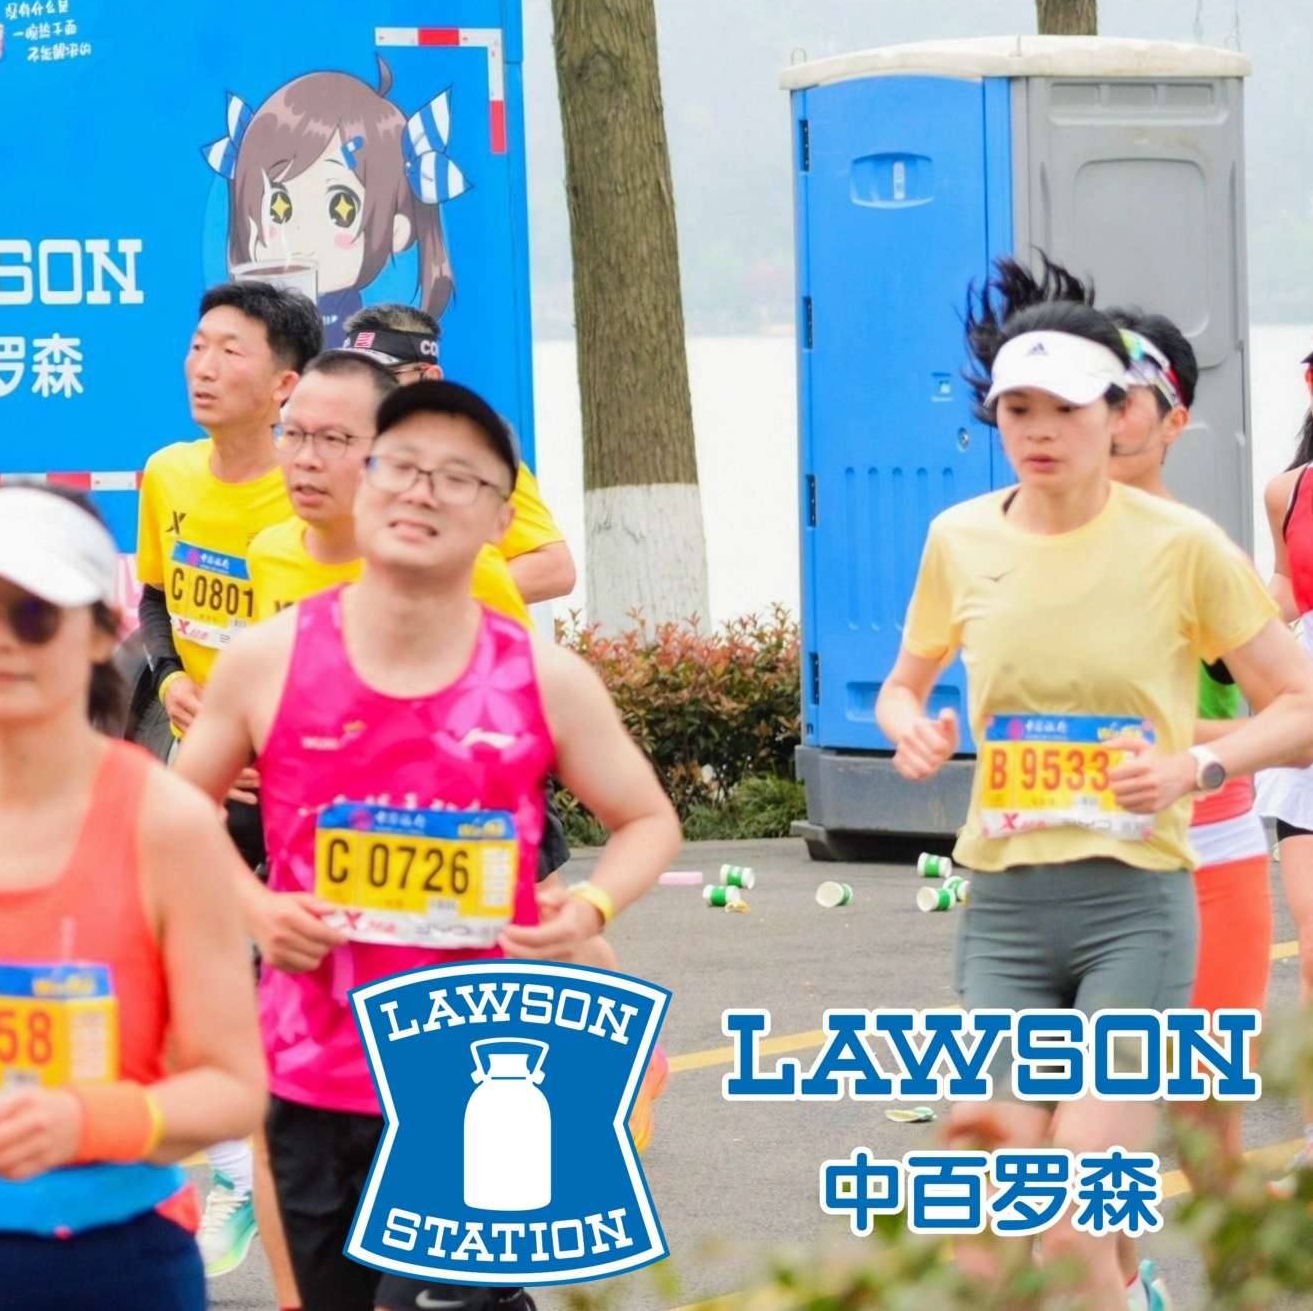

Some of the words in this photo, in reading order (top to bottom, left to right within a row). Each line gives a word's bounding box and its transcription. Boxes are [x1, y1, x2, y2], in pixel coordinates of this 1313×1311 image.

[171, 568, 185, 601] C
[193, 575, 255, 618] 0801
[990, 747, 1008, 790] B
[1020, 747, 1110, 791] 9533
[327, 839, 350, 883] C
[368, 843, 470, 894] 0726
